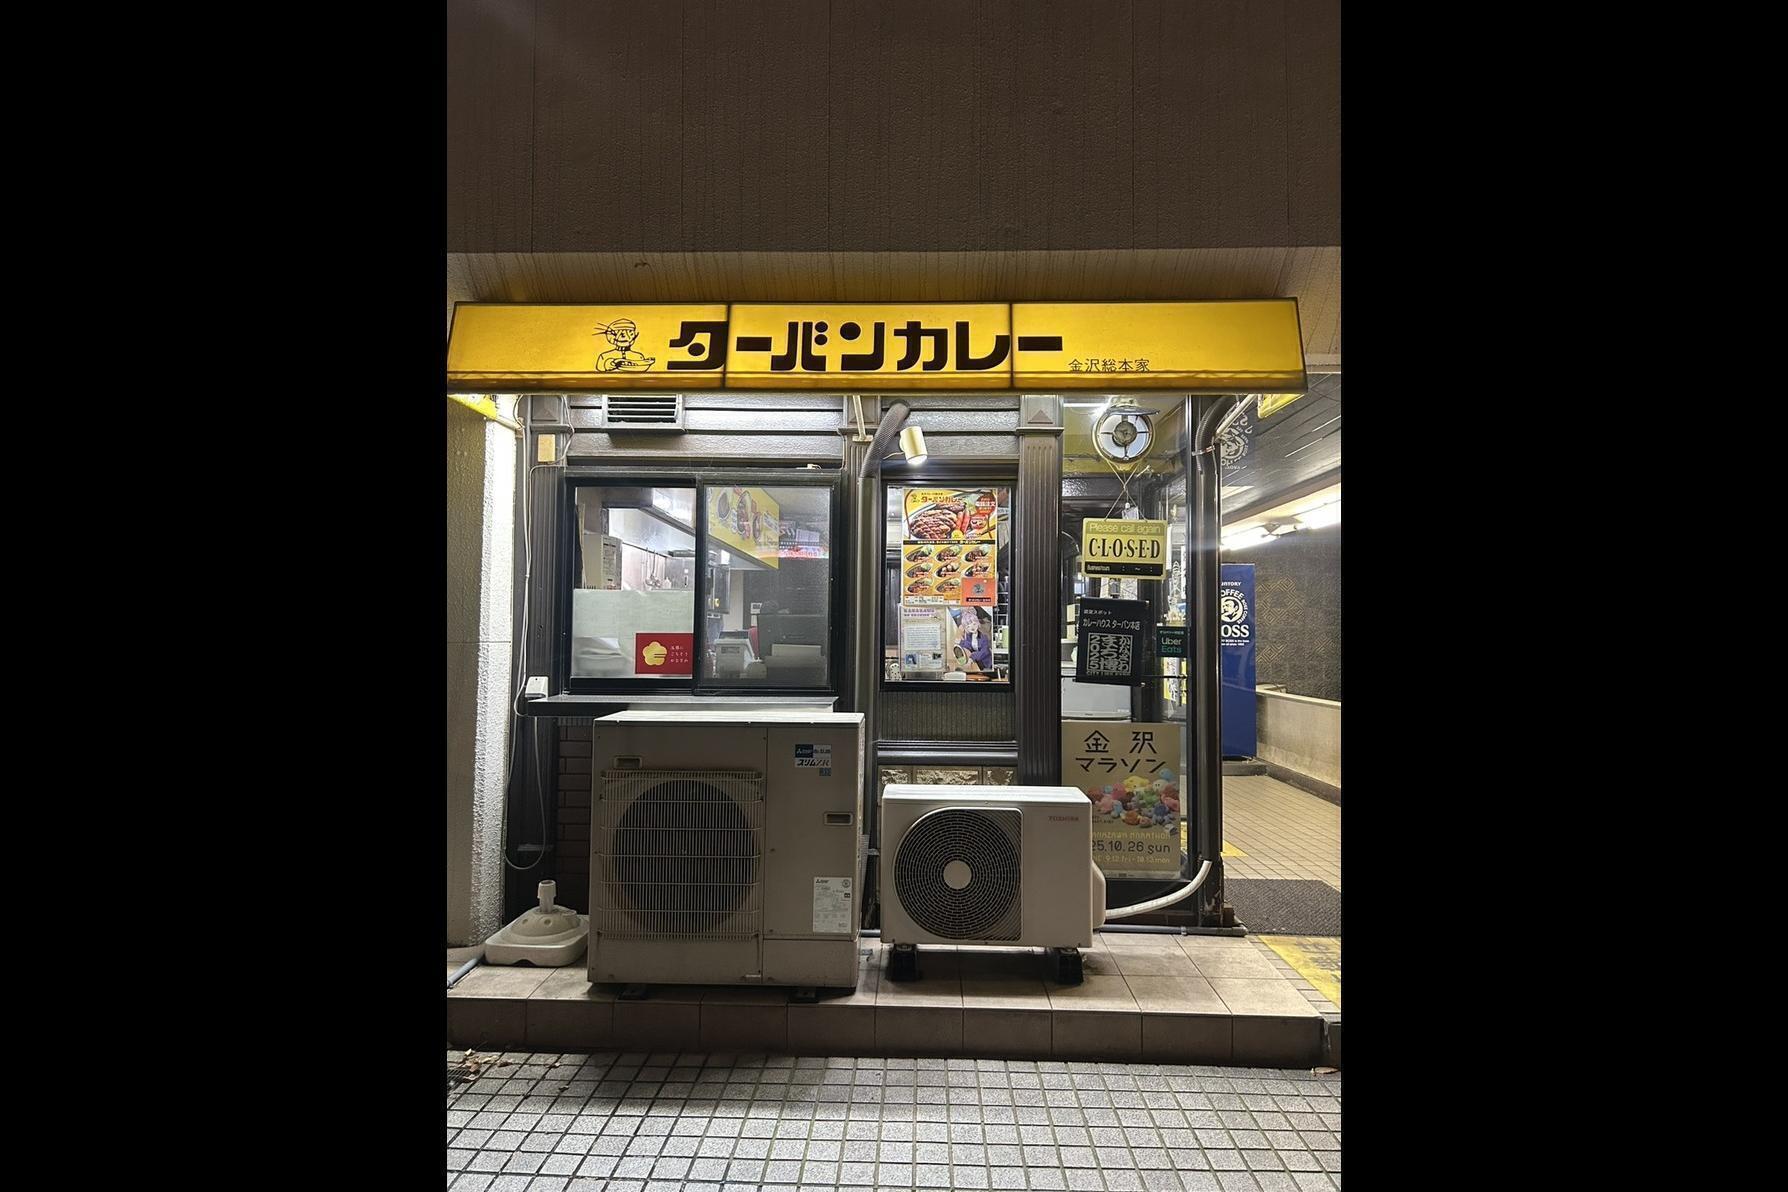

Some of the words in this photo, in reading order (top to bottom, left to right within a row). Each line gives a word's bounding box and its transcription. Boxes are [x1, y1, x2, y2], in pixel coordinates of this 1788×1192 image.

[667, 320, 1062, 371] ターバンカレー
[1068, 358, 1151, 373] 金沢総本家
[1089, 523, 1118, 532] Please
[1121, 524, 1135, 533] call
[1138, 524, 1161, 535] again
[1221, 588, 1245, 600] OFFEE
[1221, 624, 1249, 637] OSS
[1161, 637, 1182, 645] Uber
[1089, 635, 1101, 669] 2025
[1161, 645, 1182, 653] Eats
[1084, 730, 1157, 754] 金沢
[1075, 757, 1166, 774] マラソン
[1147, 844, 1171, 855] sun
